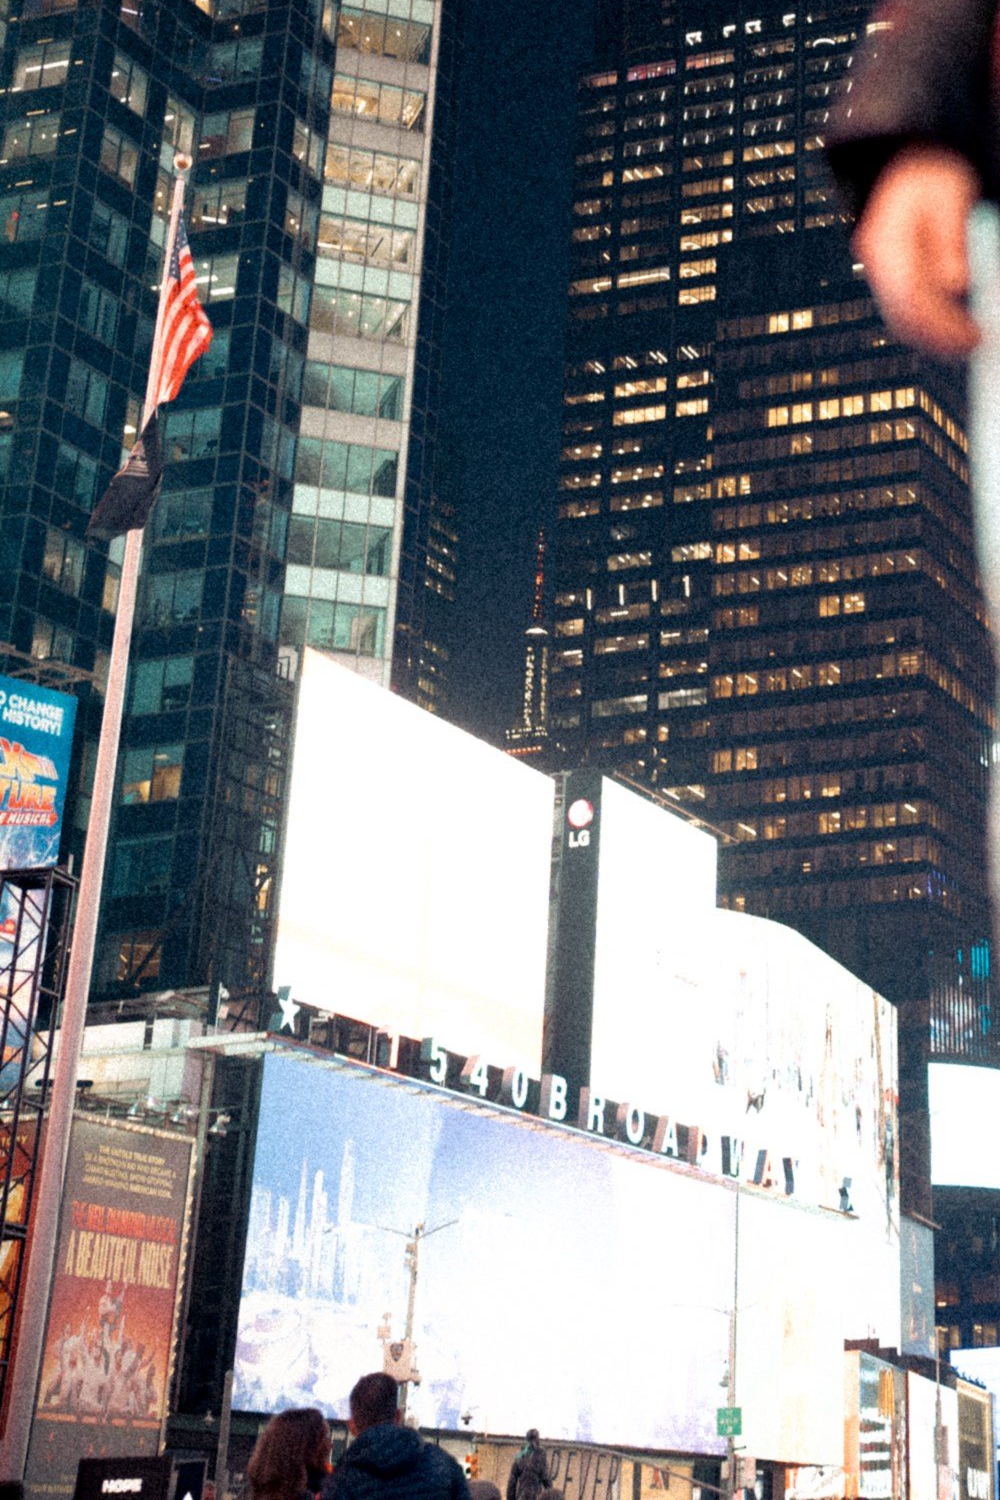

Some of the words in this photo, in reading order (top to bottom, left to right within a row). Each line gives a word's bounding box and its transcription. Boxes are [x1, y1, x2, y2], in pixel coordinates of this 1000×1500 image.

[9, 694, 64, 721] CHANGE
[2, 709, 63, 736] HISTORY!
[0, 779, 57, 812] TURE
[8, 811, 52, 825] MUSICAL
[568, 829, 591, 848] LG
[378, 1026, 529, 1109] 1540
[547, 1074, 801, 1196] BROADWAY
[65, 1229, 76, 1276] A
[75, 1231, 138, 1284] BEAUTIFUL
[138, 1240, 175, 1290] NOISE
